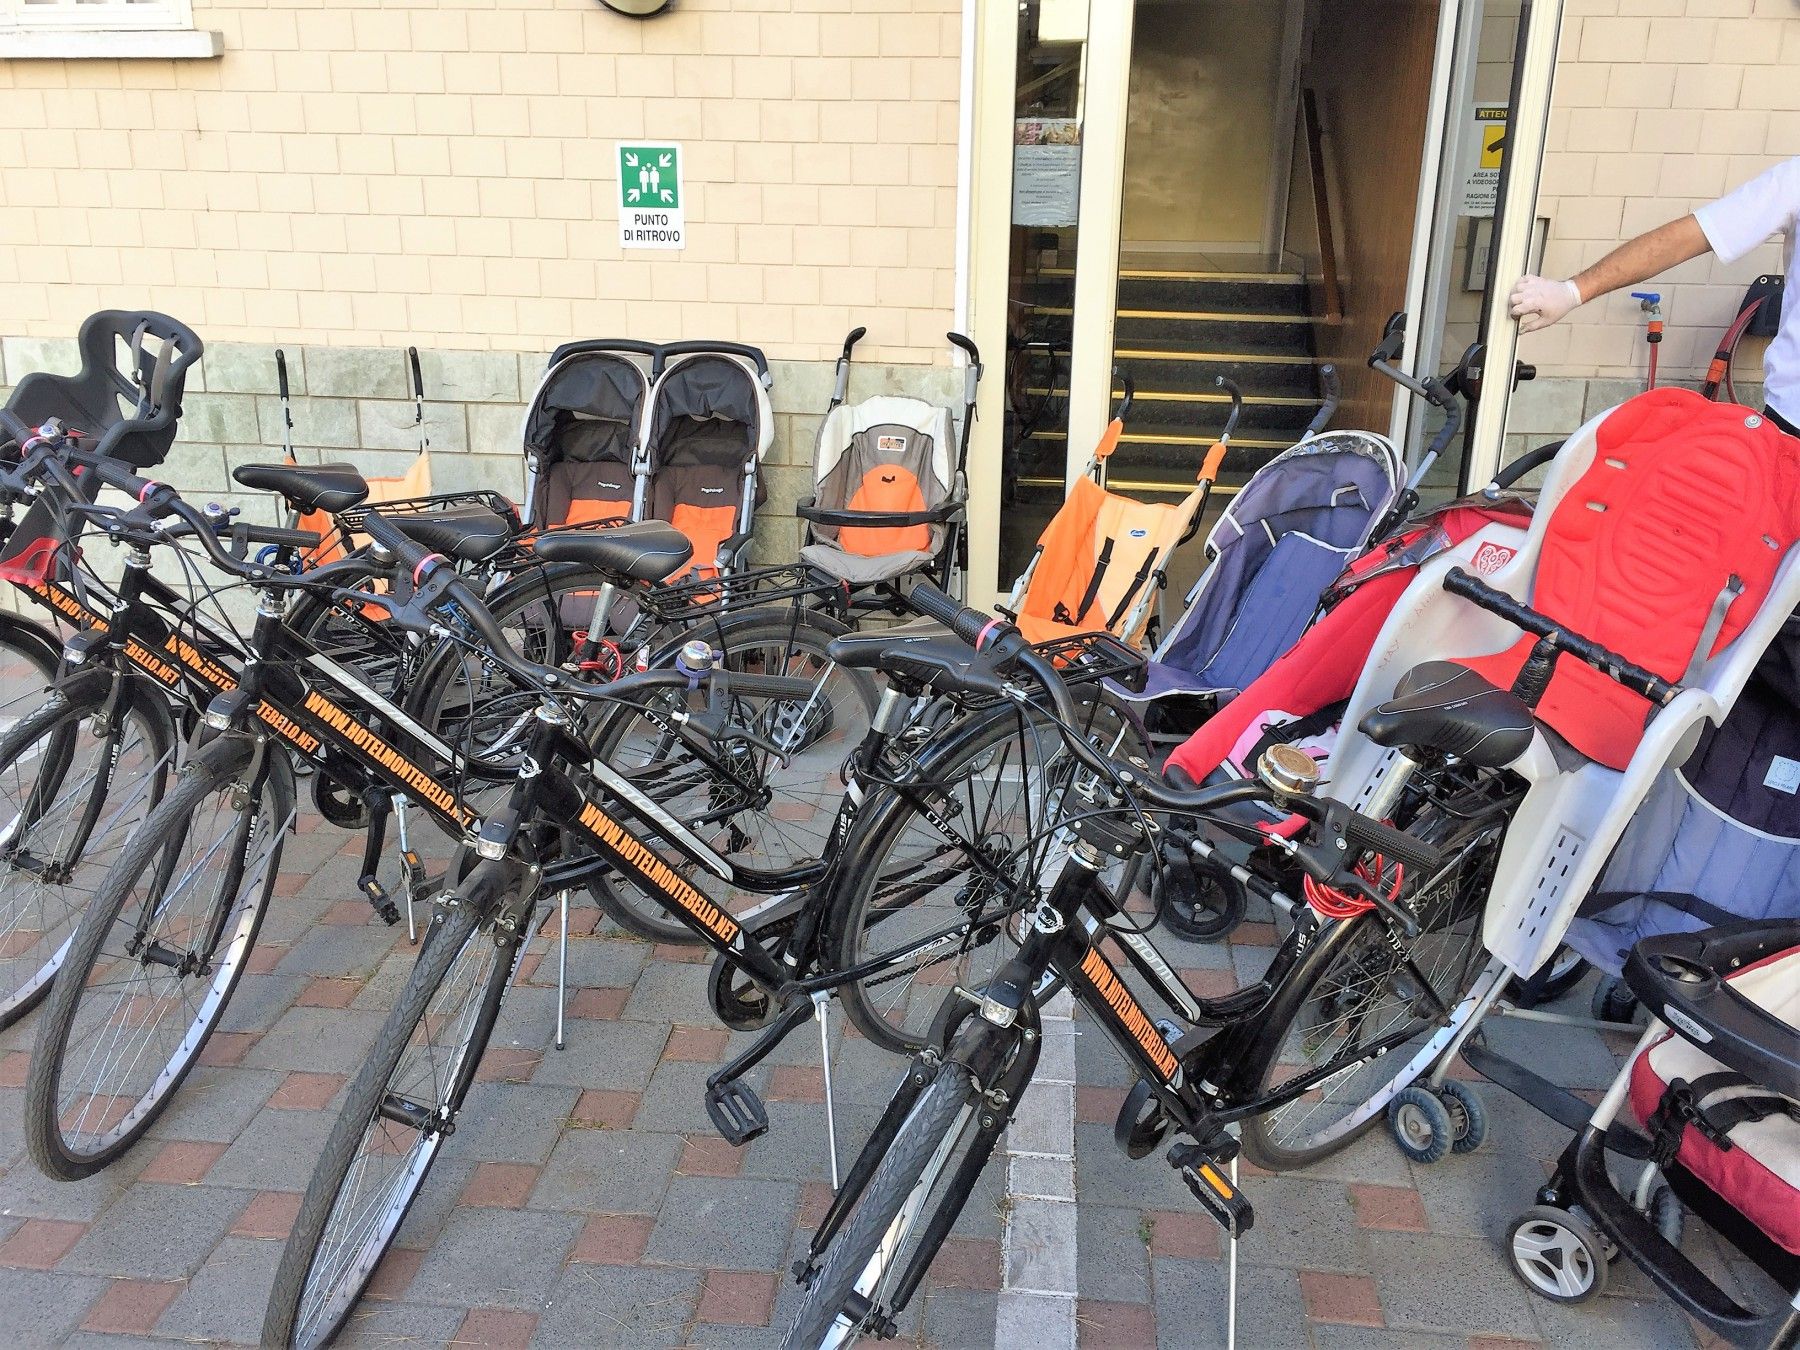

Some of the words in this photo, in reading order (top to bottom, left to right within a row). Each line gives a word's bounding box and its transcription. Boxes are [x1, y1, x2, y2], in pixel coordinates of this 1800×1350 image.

[624, 229, 633, 241] DI
[636, 230, 680, 242] RITROVO
[634, 214, 669, 226] PUNTO
[256, 699, 320, 753] TEBELLO.NET
[579, 802, 739, 942] WWW.HOTELMONTEBELLO.NET
[1081, 946, 1179, 1080] WWW.HOTELMONTEBELLO.NET
